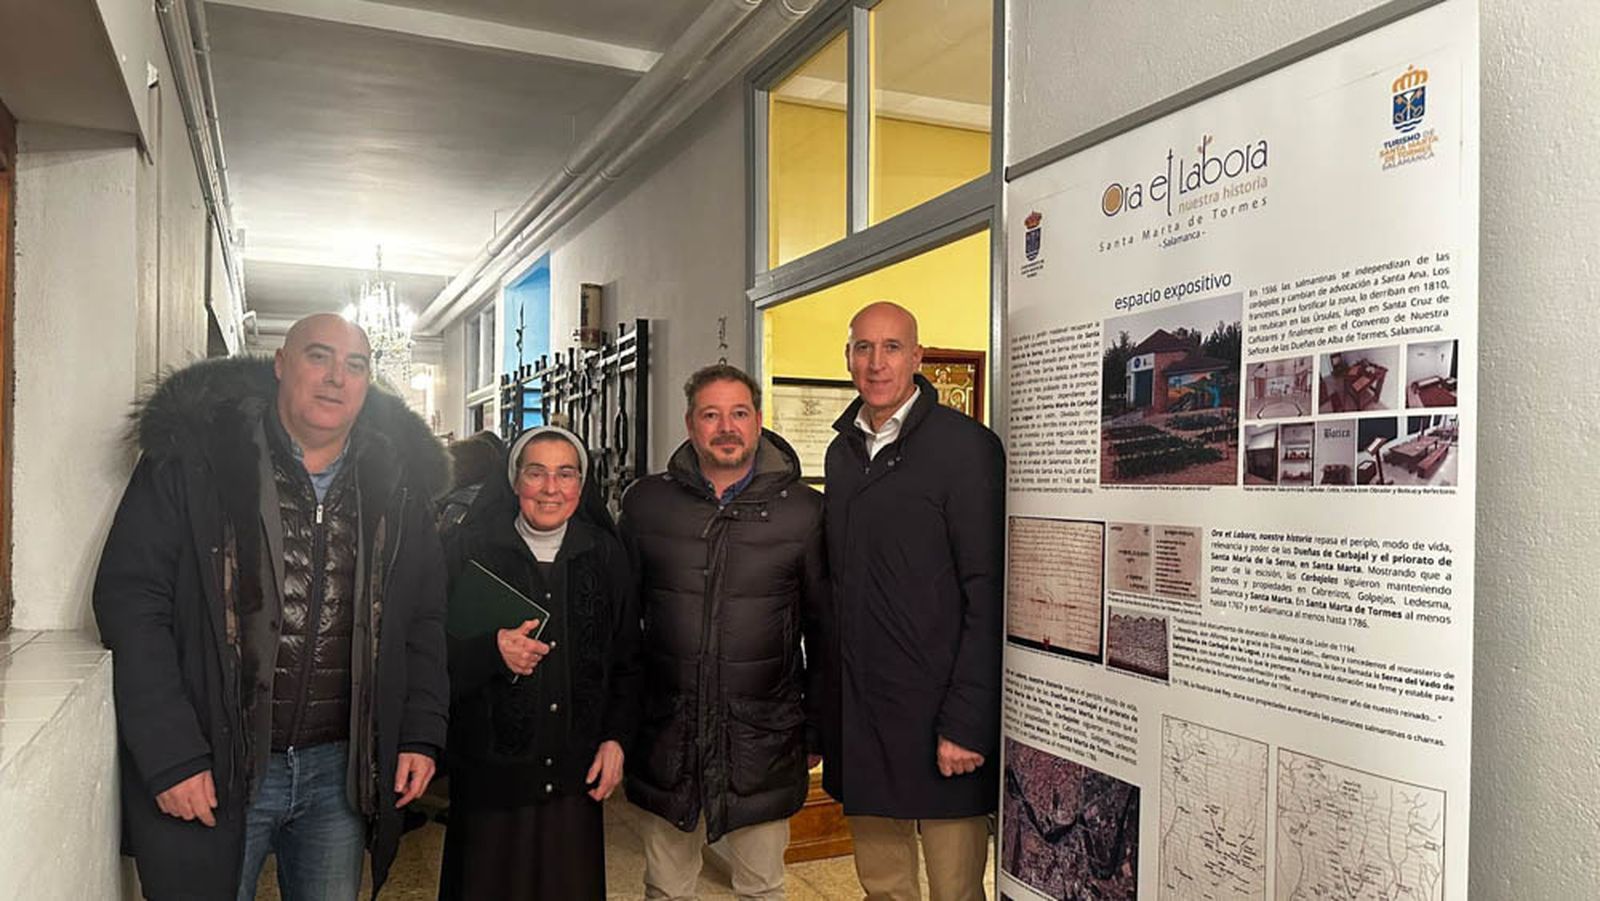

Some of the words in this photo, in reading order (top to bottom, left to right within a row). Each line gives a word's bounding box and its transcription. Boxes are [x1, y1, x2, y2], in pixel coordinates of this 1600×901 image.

[1384, 132, 1421, 148] TURISMO
[1102, 183, 1143, 217] Ora
[1150, 148, 1173, 216] et
[1179, 134, 1268, 194] Labora
[1178, 190, 1220, 214] nuestra
[1222, 176, 1268, 201] historia
[1099, 234, 1134, 252] Santa
[1142, 222, 1180, 240] Marta
[1188, 214, 1203, 227] de
[1212, 196, 1267, 220] Tormes
[1355, 260, 1411, 275] independizan
[1114, 288, 1160, 312] espacio
[1164, 272, 1232, 300] expositivo
[1330, 280, 1371, 293] advocación
[1382, 274, 1406, 283] Santa
[1281, 306, 1297, 316] para
[1370, 288, 1406, 298] derriban
[1424, 280, 1449, 290] 1810,
[1344, 308, 1366, 316] luego
[1383, 301, 1407, 310] Santa
[1410, 298, 1432, 306] Cruz
[1352, 316, 1390, 327] Convento
[1410, 309, 1449, 320] Nuestra
[1290, 340, 1316, 349] Dueñas
[1328, 336, 1343, 344] Alba
[1390, 325, 1443, 336] Salamanca.
[1294, 547, 1320, 556] Dueñas
[1335, 550, 1369, 561] Carbajal
[1392, 555, 1434, 564] priorato
[1438, 558, 1452, 566] de
[1428, 543, 1452, 553] vida,
[1275, 558, 1298, 568] Serna,
[1312, 561, 1334, 570] Santa
[1337, 564, 1364, 573] Marta.
[1368, 566, 1417, 577] Mostrando
[1344, 578, 1381, 588] siguieron
[1387, 583, 1452, 594] manteniendo
[1250, 592, 1269, 601] Santa
[1306, 599, 1327, 608] Santa
[1329, 602, 1353, 611] Marta
[1368, 607, 1402, 618] Tormes
[1416, 614, 1452, 623] menos
[1403, 597, 1452, 611] Ledesma,
[1327, 615, 1347, 624] hasta
[1382, 673, 1402, 682] Serna
[1419, 679, 1441, 688] Vado
[1397, 666, 1441, 677] monasterio
[1405, 689, 1432, 698] estable
